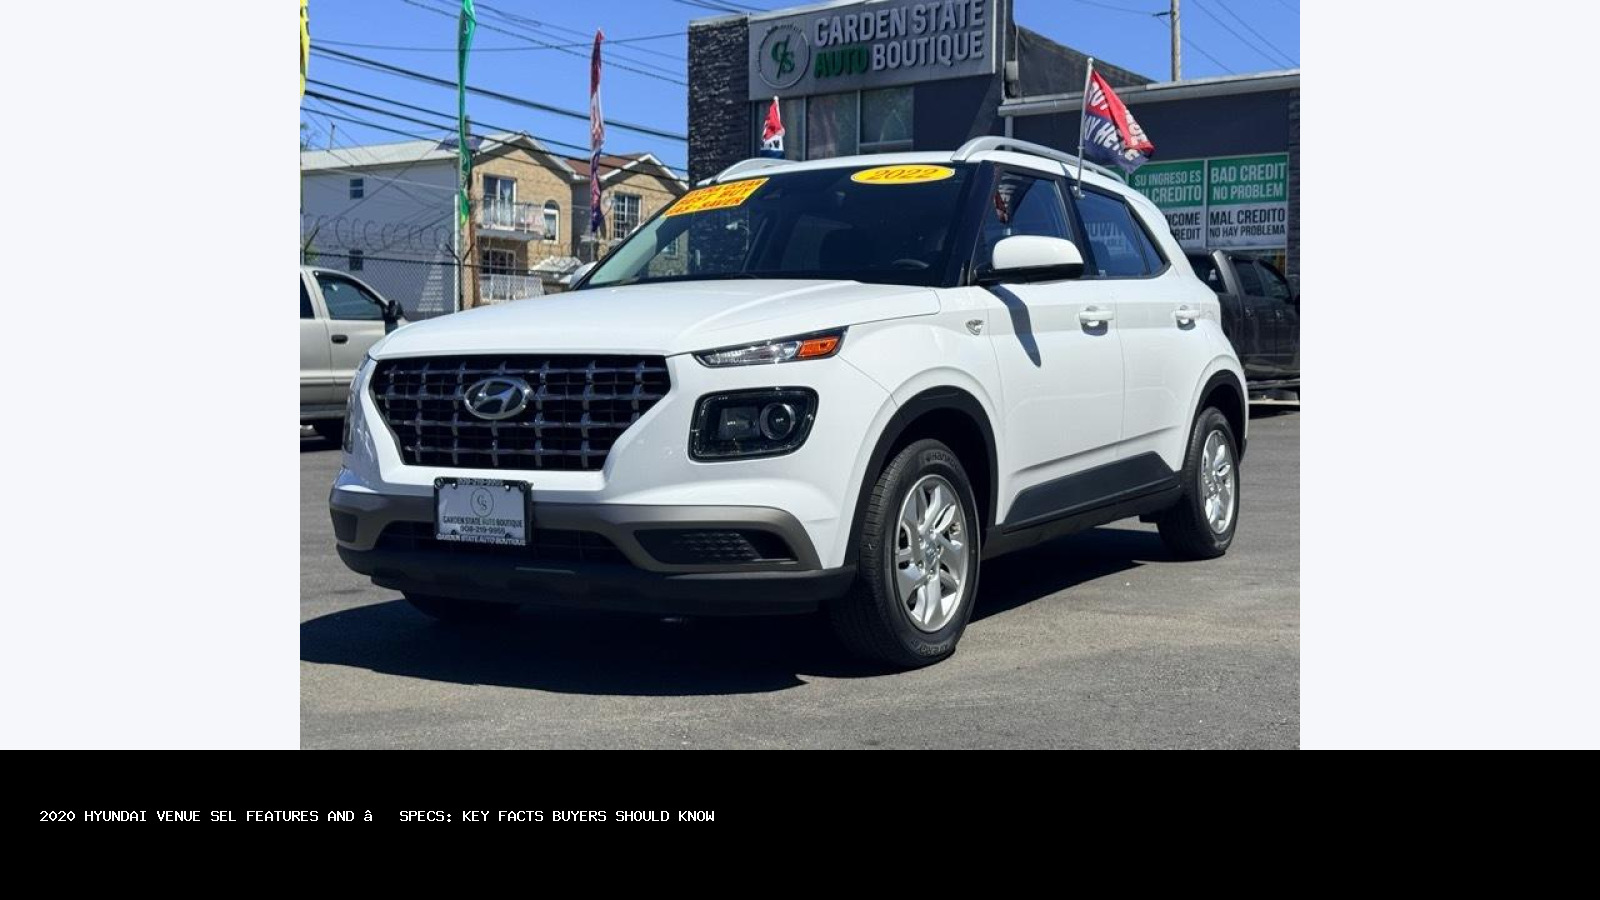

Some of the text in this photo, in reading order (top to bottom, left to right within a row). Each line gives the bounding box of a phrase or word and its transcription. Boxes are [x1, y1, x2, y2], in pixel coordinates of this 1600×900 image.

[814, 0, 985, 47] GARDEN STATE
[814, 30, 984, 78] AUTO BOUTIQUE
[865, 168, 939, 181] 2022
[1134, 169, 1202, 187] SU INGRESO ES
[1210, 162, 1287, 185] BAD CREDIT
[1151, 185, 1202, 203] CREDITO
[1213, 182, 1283, 200] NO PROBLEM
[1209, 208, 1285, 226] MAL CREDITO
[1209, 224, 1285, 238] NO HAY PROBLEMA
[443, 515, 464, 524] GARDEN
[465, 517, 481, 525] STATE
[496, 519, 522, 528] BOUTIQUE
